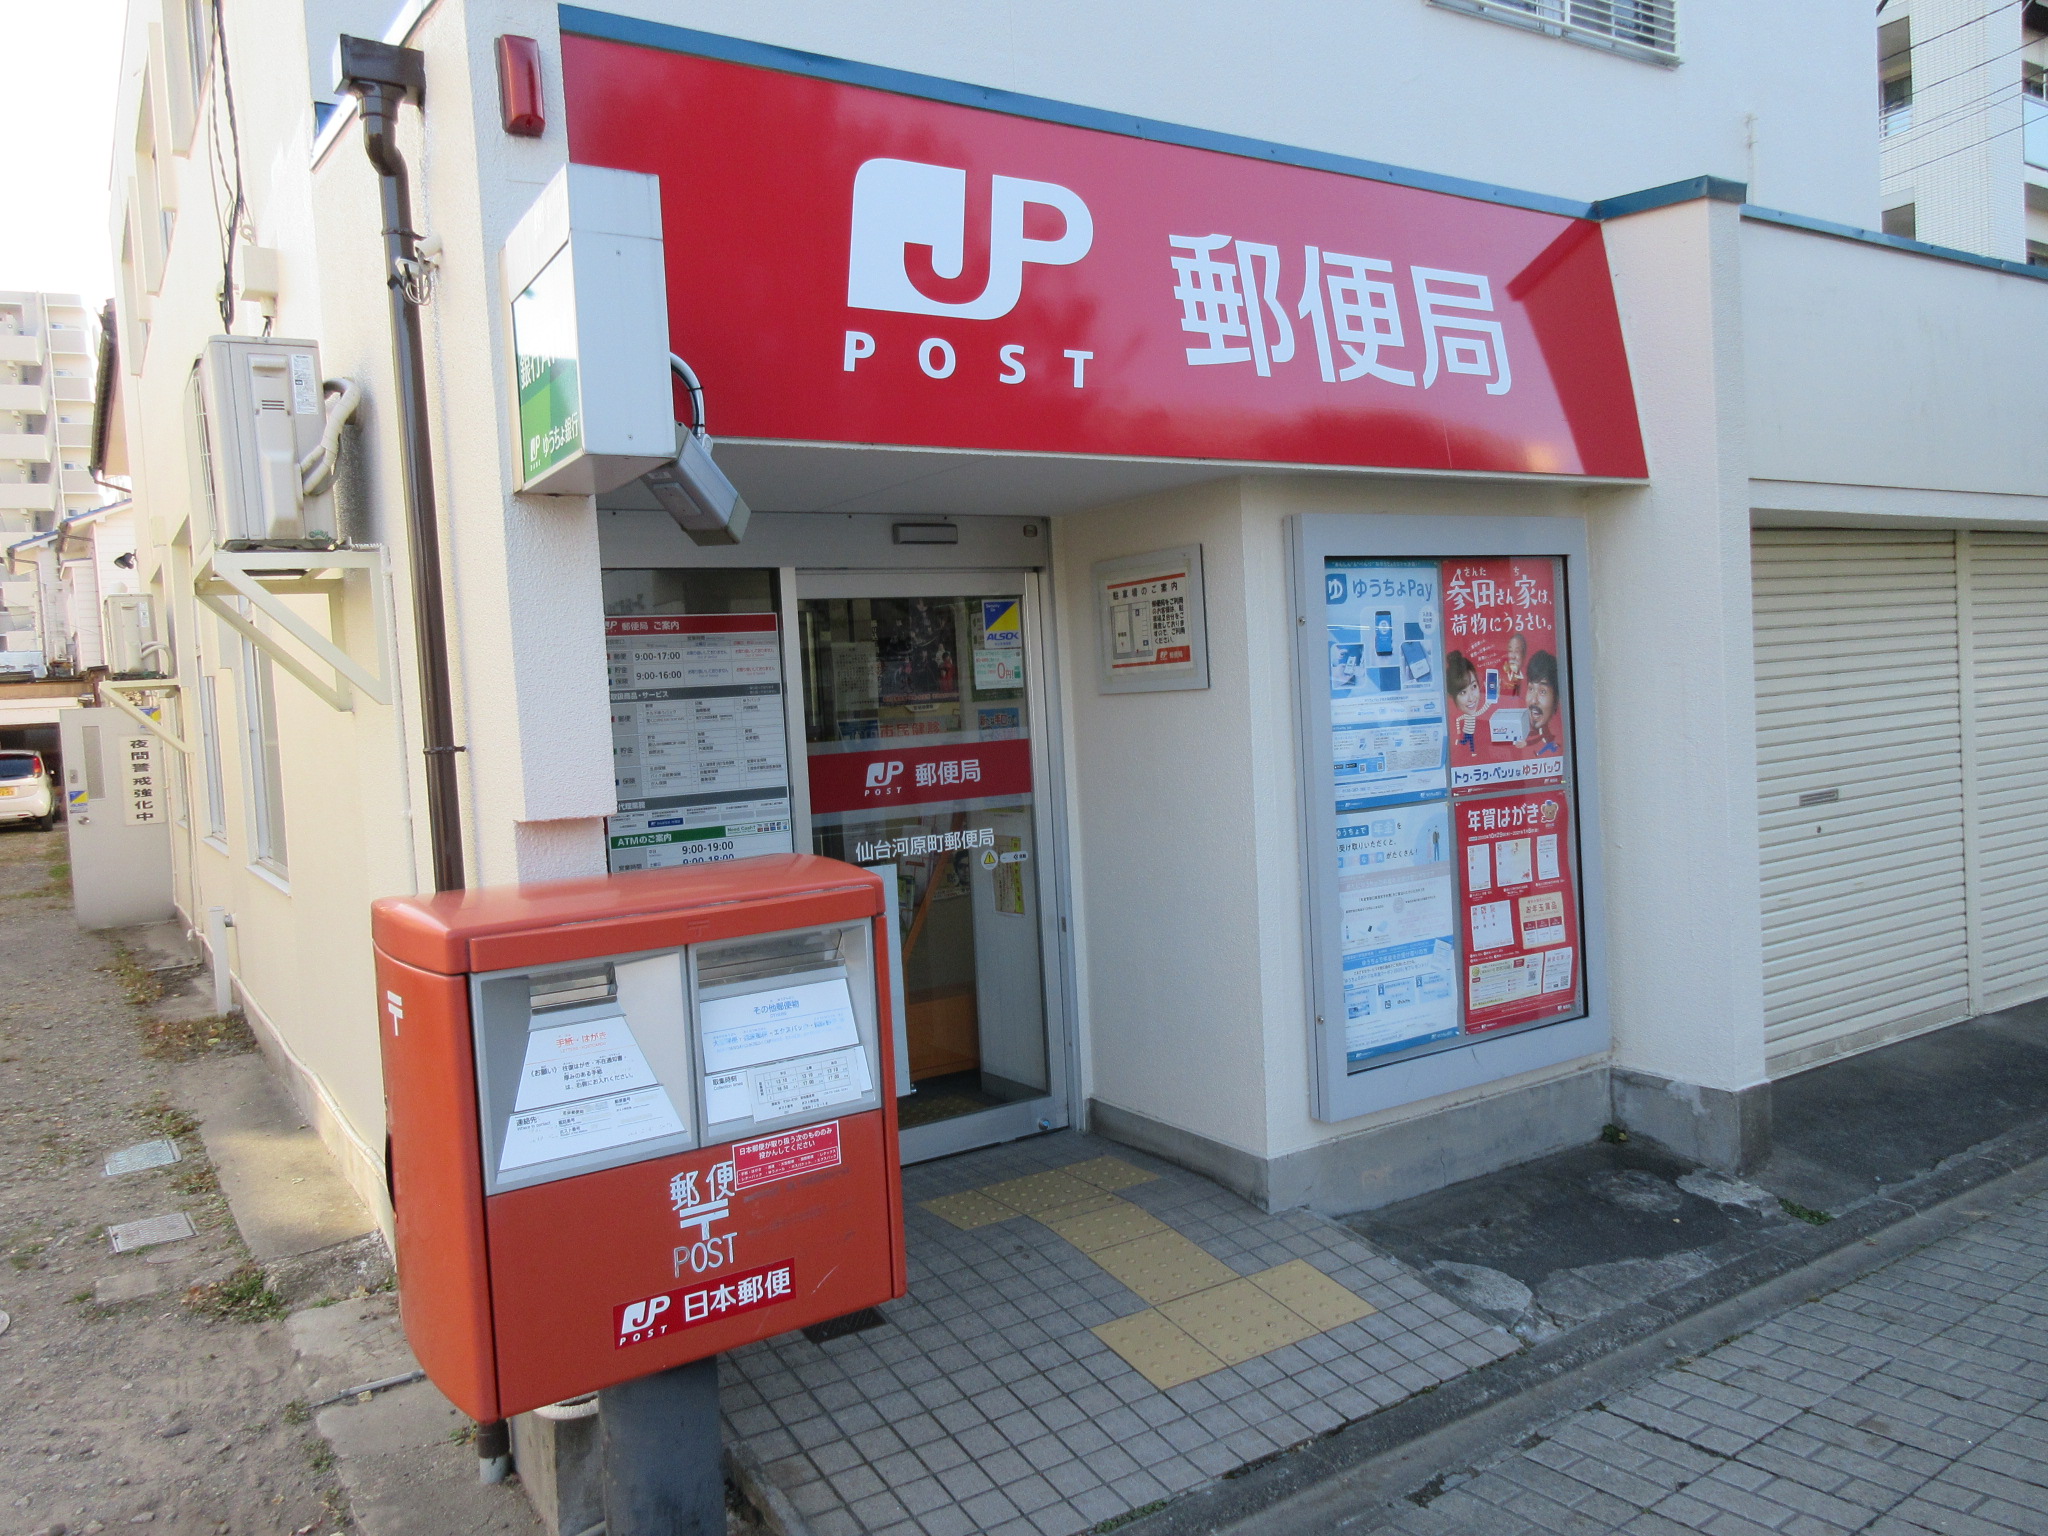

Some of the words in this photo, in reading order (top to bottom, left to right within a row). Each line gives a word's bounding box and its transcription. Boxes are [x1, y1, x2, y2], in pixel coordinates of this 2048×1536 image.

[1168, 233, 1513, 396] 郵便局
[843, 330, 1094, 389] POST
[542, 411, 579, 458] ゆうちょ銀行
[1464, 566, 1487, 577] さんた
[1513, 566, 1520, 577] ち
[1112, 581, 1178, 600] 駐車場のご案内
[1352, 578, 1433, 602] ゆうちょPay
[1446, 568, 1552, 611] 参田さん家は、
[621, 620, 649, 631] 郵便局
[653, 620, 680, 631] ご案内
[1450, 612, 1552, 637] 荷物にうるさい。
[986, 631, 1019, 641] ALSOK
[634, 651, 681, 661] 9:00-17:00
[636, 670, 682, 681] 9:00-16:00
[880, 721, 940, 738] 市民健診
[129, 738, 154, 822] 夜間警戒強化中
[915, 758, 982, 788] 郵便局
[1454, 761, 1561, 785] トク・ラク・ベンリなゆうパック
[864, 786, 902, 797] POST
[1467, 803, 1540, 832] 年賀はがき
[617, 833, 672, 847] ATMのご案内
[681, 841, 734, 855] 9:00-19:00
[855, 827, 995, 863] 仙台河原町郵便局
[1336, 839, 1397, 853] 受け取りいただくと、
[753, 999, 800, 1015] その他郵便物
[556, 1031, 607, 1048] 手紙・はがき
[563, 1068, 603, 1081] 厚みのある手紙
[712, 1074, 738, 1086] 取集時刻
[516, 1116, 538, 1127] 連絡先
[739, 1127, 833, 1156] 日本郵便が取り扱う次のもののみ
[758, 1140, 816, 1160] 投かんしてください
[669, 1160, 736, 1211] 郵便
[672, 1232, 739, 1279] POST
[684, 1266, 793, 1323] 日本郵便
[618, 1324, 669, 1347] POST
